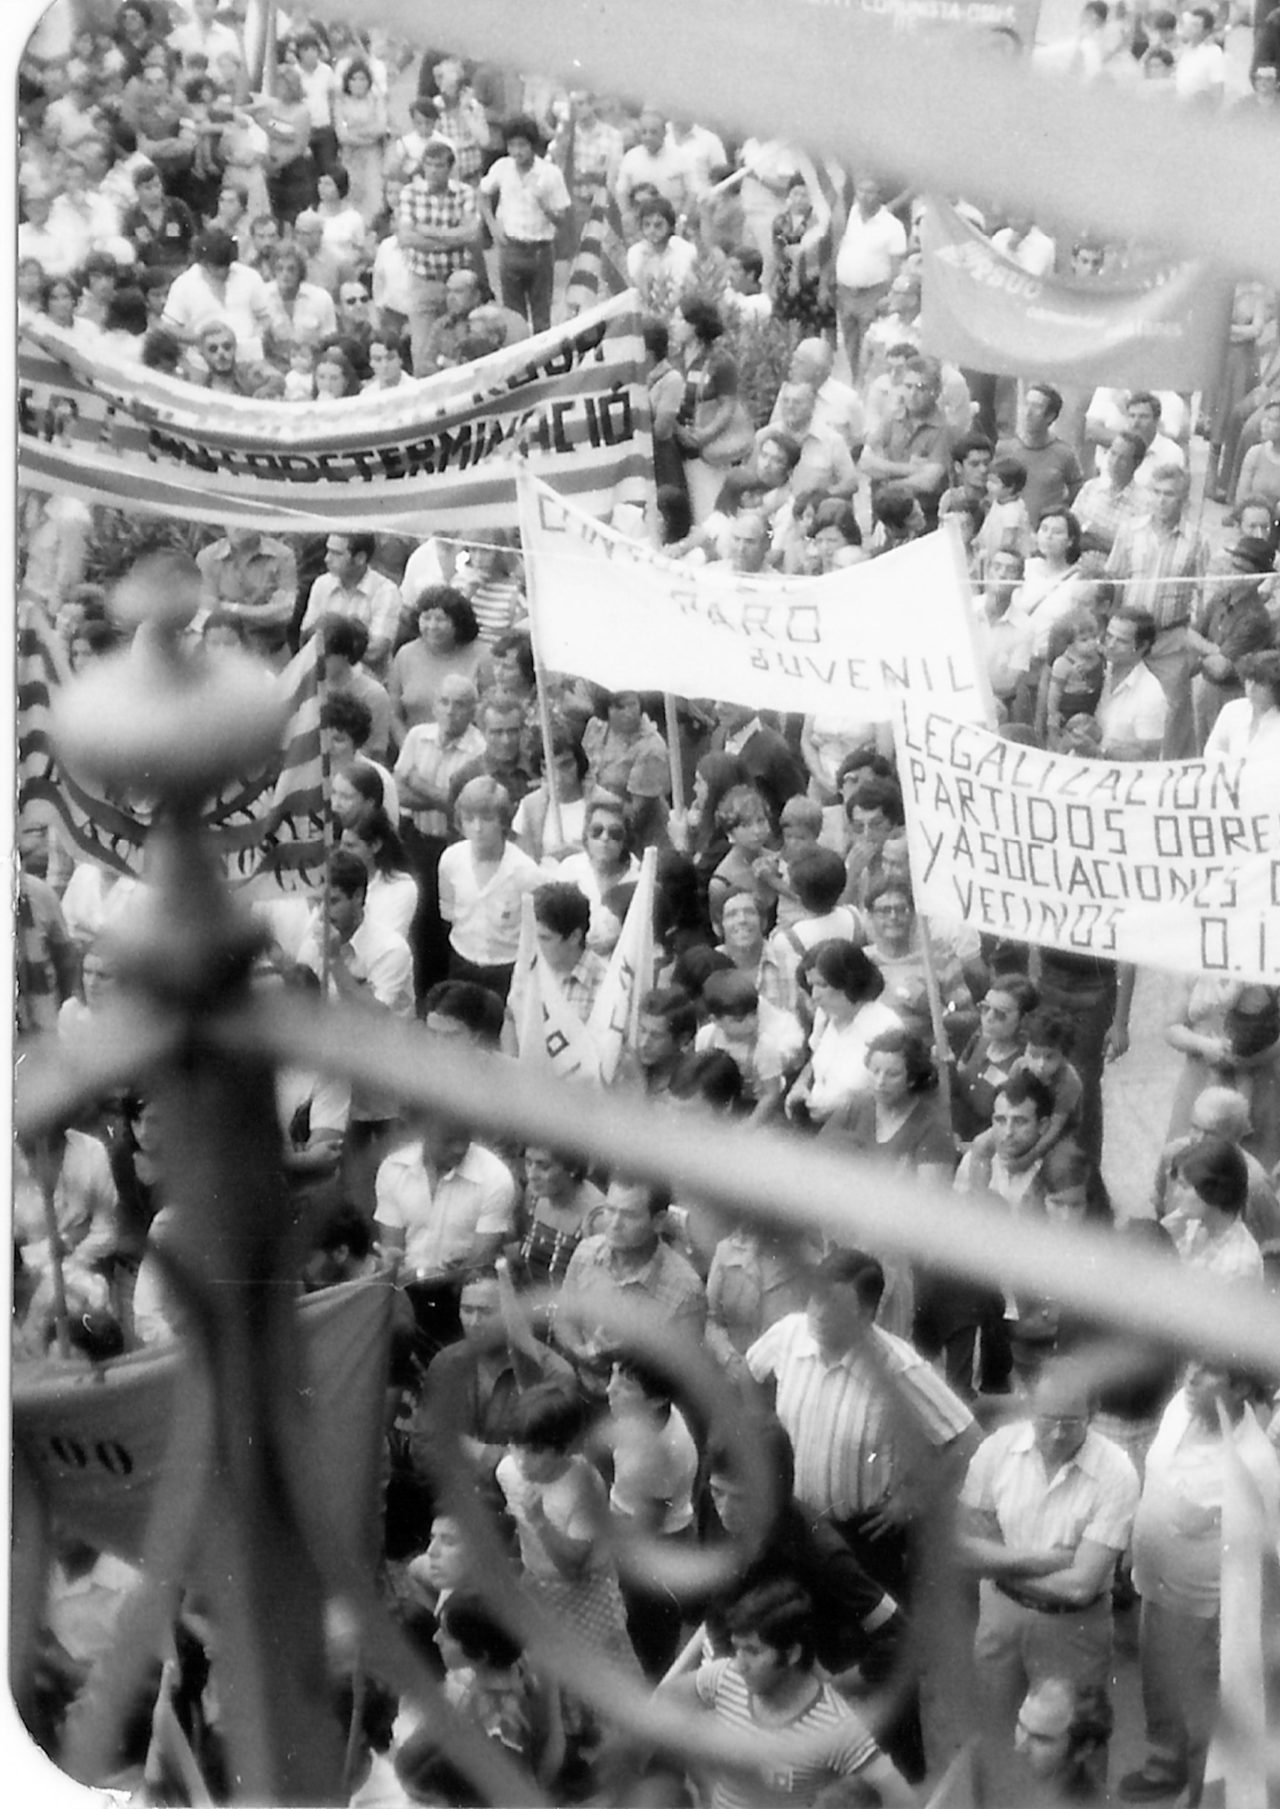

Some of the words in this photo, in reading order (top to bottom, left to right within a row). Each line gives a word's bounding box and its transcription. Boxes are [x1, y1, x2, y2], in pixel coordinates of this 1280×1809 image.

[902, 699, 1246, 811] LEGALIZACION
[909, 757, 1127, 855] PARTIDOS
[952, 875, 1124, 950] VECINOS
